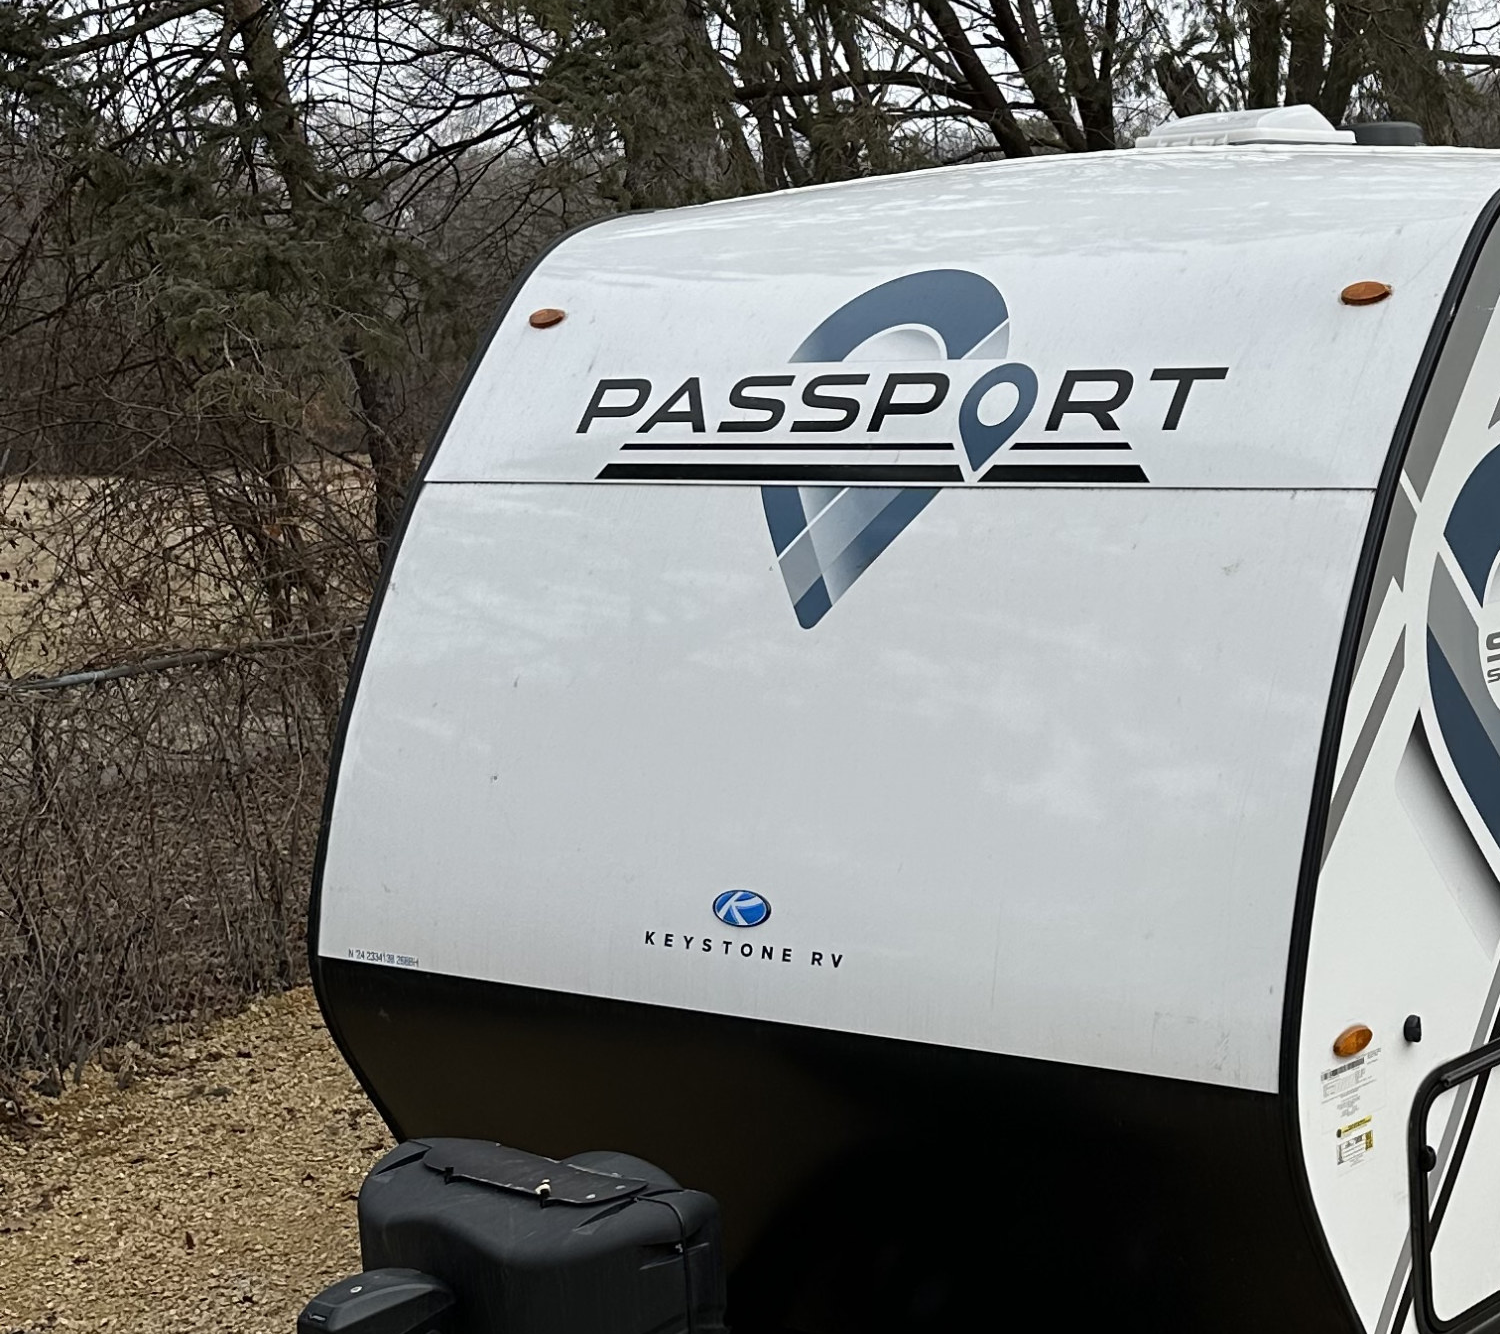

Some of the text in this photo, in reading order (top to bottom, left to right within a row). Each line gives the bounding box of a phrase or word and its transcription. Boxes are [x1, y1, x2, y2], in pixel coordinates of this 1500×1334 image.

[575, 362, 1230, 471] PASSPORT
[644, 930, 844, 969] KEYSTONE RV
